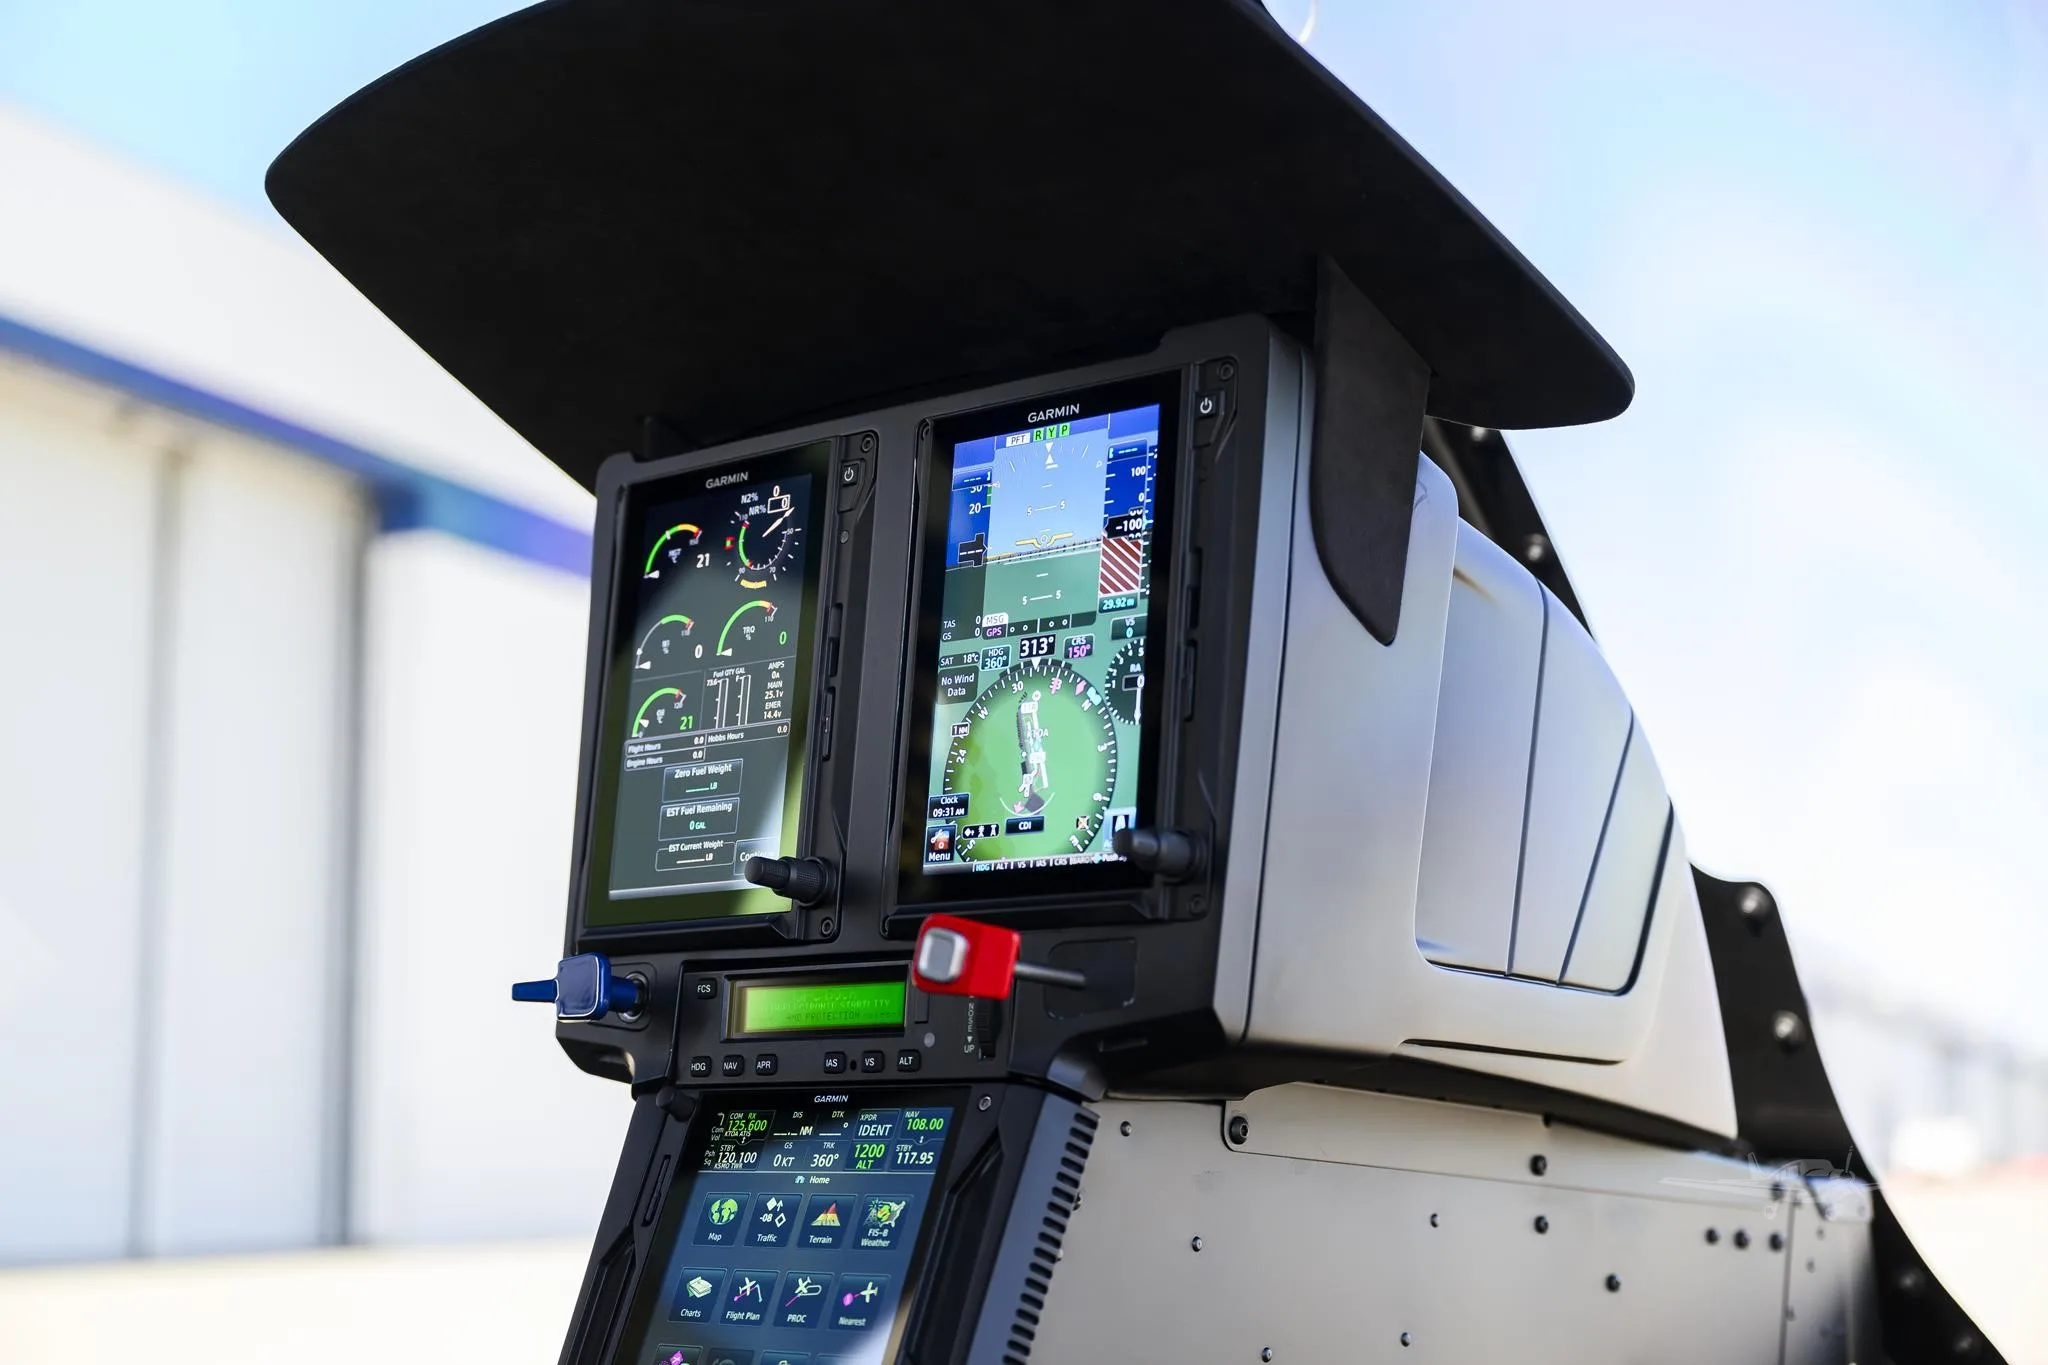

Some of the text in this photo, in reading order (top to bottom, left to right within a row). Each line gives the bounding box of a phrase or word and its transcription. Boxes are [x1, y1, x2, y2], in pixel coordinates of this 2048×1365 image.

[1028, 404, 1080, 423] GARMIN
[1036, 424, 1068, 440] R Y P
[1011, 435, 1026, 444] PFT
[1131, 466, 1146, 477] 100
[706, 472, 748, 488] GARMIN
[773, 485, 780, 496] 0
[1138, 492, 1144, 502] 0
[782, 498, 788, 508] 0
[1060, 500, 1065, 510] 5
[969, 503, 981, 514] 20
[1027, 507, 1032, 516] 5
[1116, 518, 1142, 532] -100
[696, 553, 710, 568] 21
[1056, 590, 1062, 600] 5
[1022, 596, 1027, 606] 5
[944, 616, 980, 628] TAS 0
[986, 615, 1004, 624] MSG
[974, 628, 980, 636] 0
[986, 627, 1002, 636] GPS
[1126, 627, 1133, 638] 0
[780, 631, 786, 644] 0
[695, 644, 702, 658] 0
[1020, 636, 1054, 656] 313°
[1068, 644, 1090, 658] 150°
[988, 648, 1004, 656] HDG
[768, 661, 784, 670] AMPS
[941, 657, 954, 666] SAT
[984, 656, 1006, 670] 360°
[942, 673, 974, 686] No Wind
[1137, 674, 1144, 688] 0
[948, 687, 966, 696] Data
[1012, 681, 1023, 693] 30
[978, 707, 988, 720] W
[680, 716, 692, 730] 21
[708, 725, 787, 742] Hobbs Hours 0.0
[694, 736, 704, 744] 0.0
[692, 750, 702, 759] 0.0
[956, 749, 966, 764] 24
[674, 764, 732, 778] Zero Fuel Weight
[666, 802, 732, 817] EST Fuel Remaining
[933, 807, 954, 817] 09:31
[1019, 822, 1032, 830] CDI
[680, 842, 702, 850] Current
[704, 840, 724, 850] Weight
[706, 853, 714, 861] LB
[928, 853, 950, 862] Menu
[976, 863, 990, 871] HDG
[996, 861, 1008, 870] ALT
[698, 984, 711, 992] FCS
[964, 1044, 975, 1054] UP
[691, 1062, 706, 1070] HDG
[724, 1062, 738, 1070] NAV
[756, 1060, 770, 1069] APR
[826, 1059, 837, 1067] IAS
[865, 1058, 874, 1066] VS
[899, 1057, 913, 1065] ALT
[730, 1112, 744, 1120] COM
[832, 1110, 845, 1118] DTK
[728, 1120, 768, 1131] 125.600
[907, 1118, 944, 1130] 108.00
[712, 1126, 724, 1134] Com
[858, 1124, 892, 1136] IDENT
[720, 1144, 735, 1152] STBY
[854, 1144, 885, 1158] 1200
[718, 1152, 757, 1164] 120.100
[810, 1153, 840, 1168] 360°
[897, 1152, 934, 1164] 117.95
[856, 1160, 874, 1170] ALT
[810, 1176, 830, 1184] Home
[708, 1232, 722, 1242] Map
[868, 1228, 888, 1236] FIS-B
[757, 1234, 777, 1242] Traffic
[860, 1238, 890, 1246] Weather
[680, 1308, 701, 1318] Charts
[726, 1310, 760, 1320] Flight Plan
[787, 1314, 806, 1322] PROC
